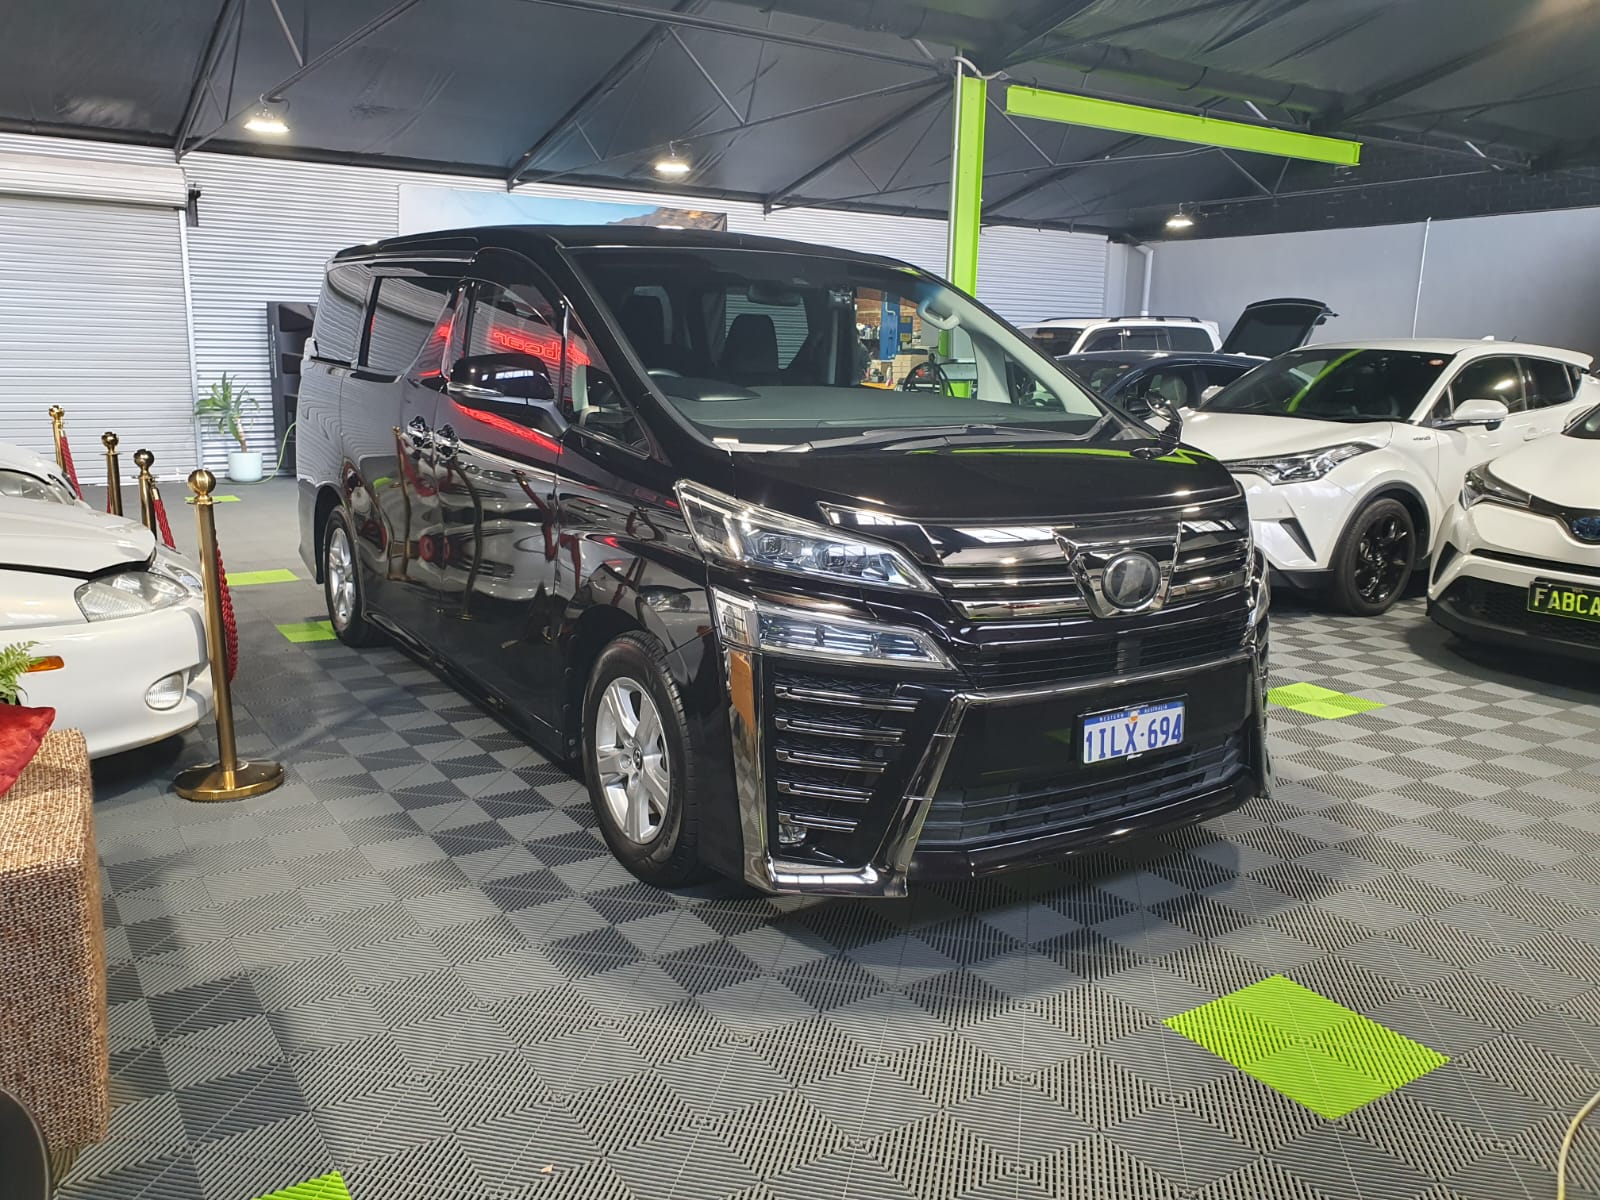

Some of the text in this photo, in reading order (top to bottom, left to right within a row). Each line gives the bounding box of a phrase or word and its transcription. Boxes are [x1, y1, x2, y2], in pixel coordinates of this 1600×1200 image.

[1534, 588, 1600, 617] FABCA
[1100, 703, 1168, 722] WESTERN AUSTRALIA
